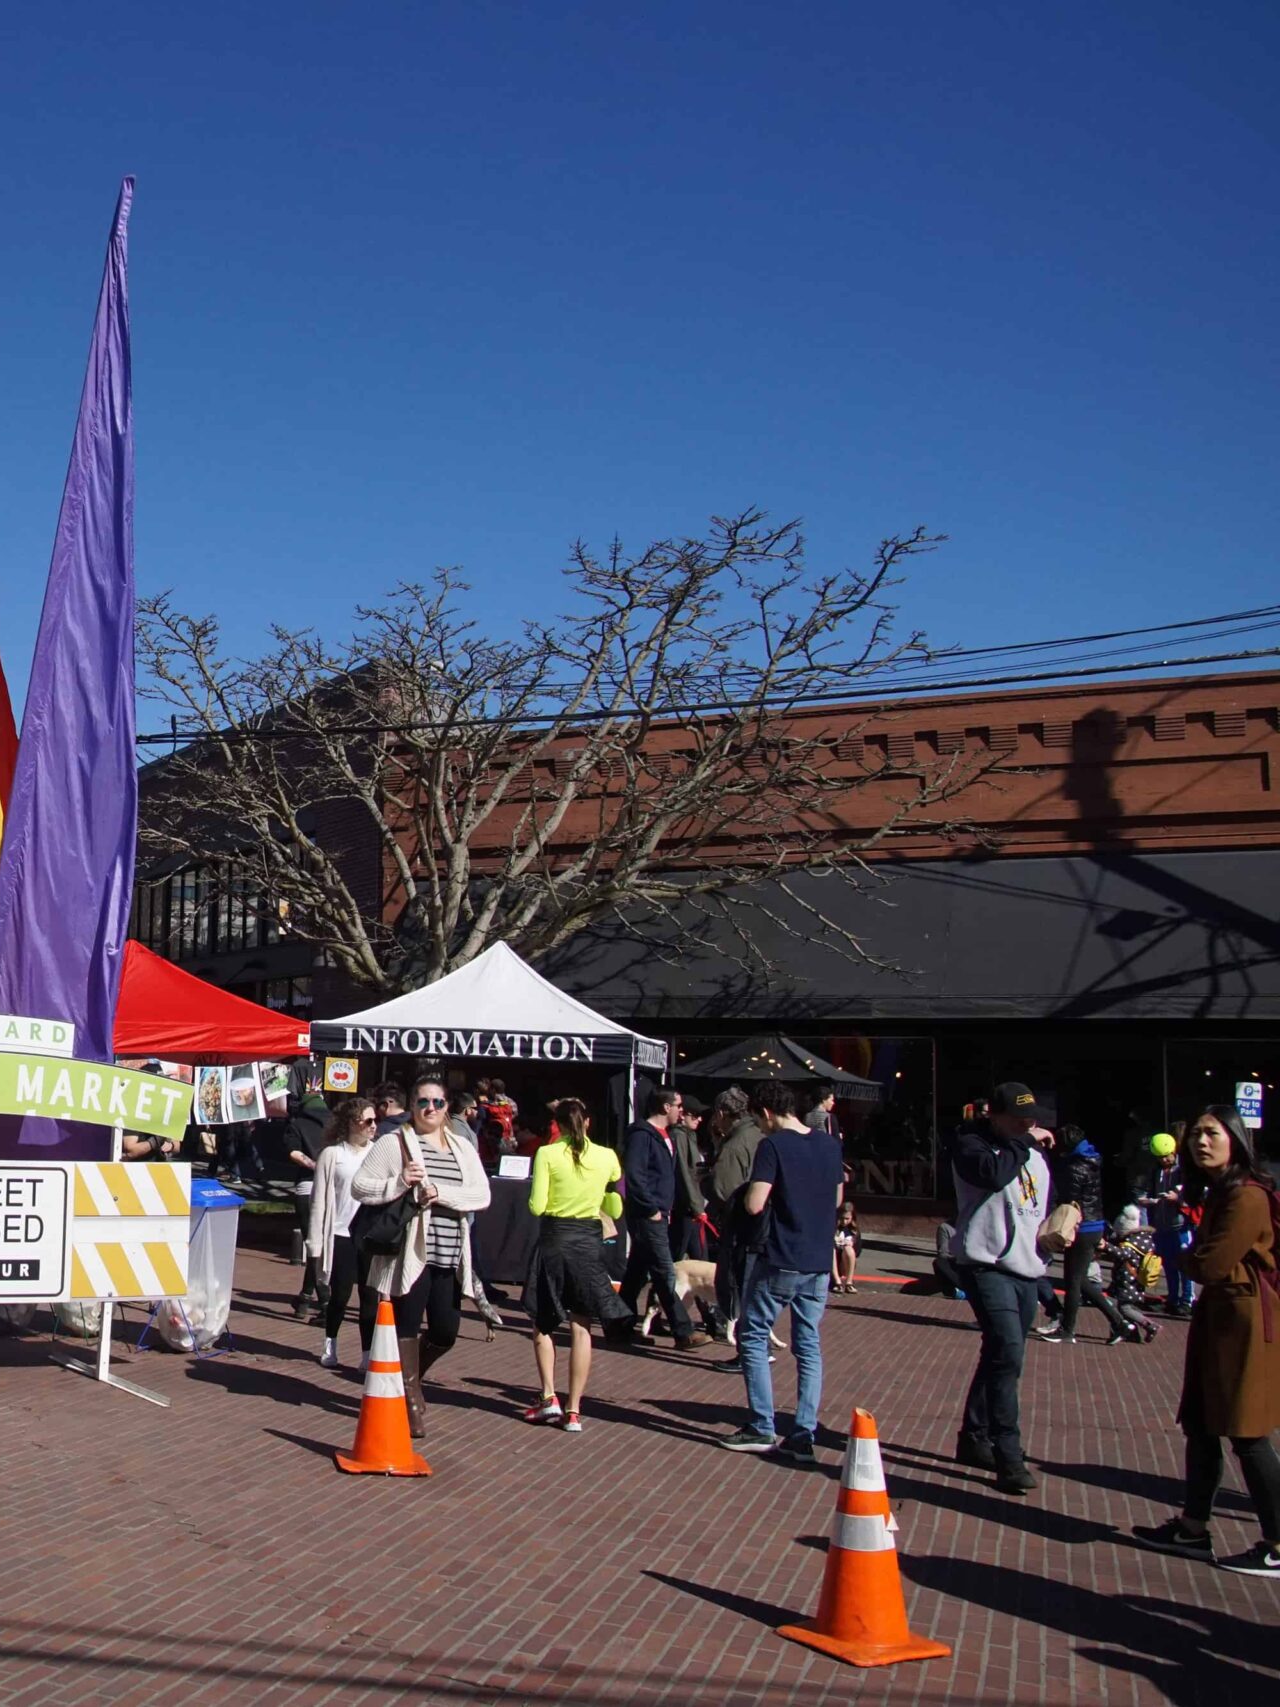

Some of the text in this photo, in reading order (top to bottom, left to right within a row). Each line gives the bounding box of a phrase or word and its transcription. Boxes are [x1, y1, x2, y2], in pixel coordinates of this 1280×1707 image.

[343, 1027, 597, 1062] INFORMATION
[16, 1064, 183, 1126] MARKET
[1237, 1099, 1260, 1108] Pay to
[1240, 1107, 1257, 1115] Park
